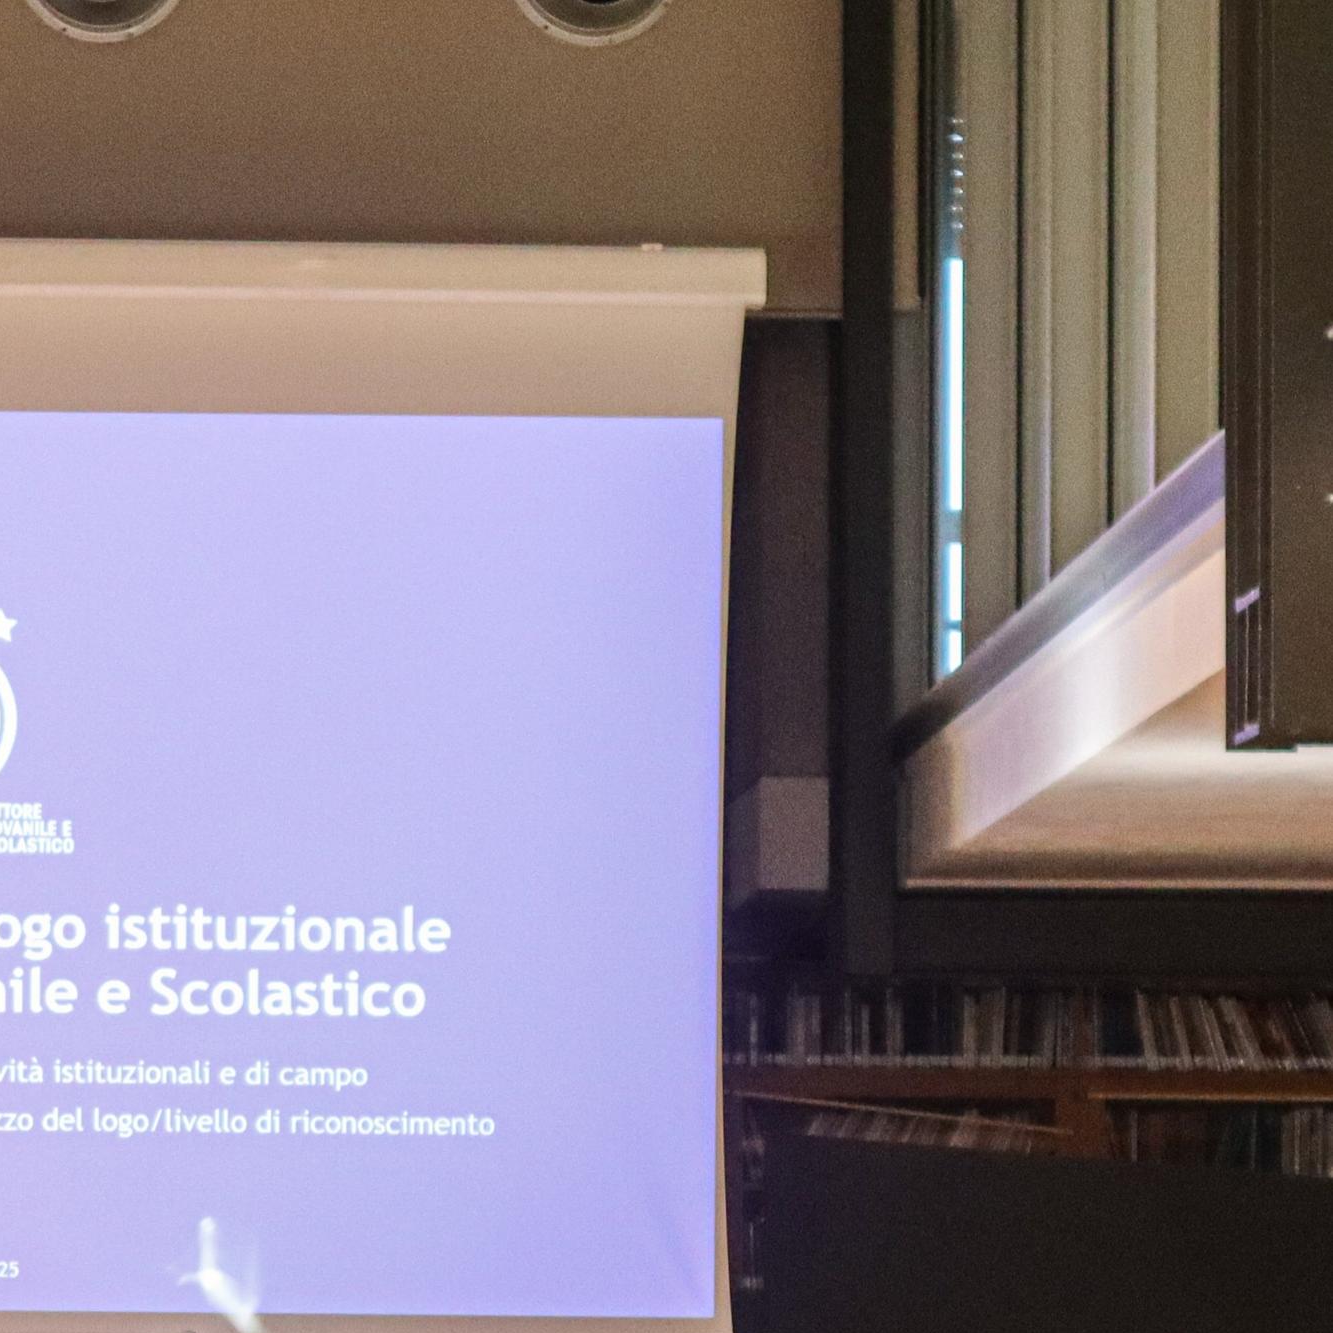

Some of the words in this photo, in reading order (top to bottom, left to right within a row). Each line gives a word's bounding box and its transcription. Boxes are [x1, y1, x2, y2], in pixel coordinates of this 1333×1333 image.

[62, 820, 73, 837] E
[104, 902, 452, 953] istituzionale
[96, 979, 131, 1015] e
[149, 967, 427, 1018] Scolastico
[53, 1058, 211, 1085] istituzionali
[218, 1066, 237, 1086] e
[244, 1060, 270, 1086] di
[278, 1067, 369, 1092] campo
[41, 1106, 84, 1132] del
[93, 1106, 248, 1139] logo/livello
[254, 1108, 281, 1134] di
[290, 1109, 496, 1137] riconoscimento
